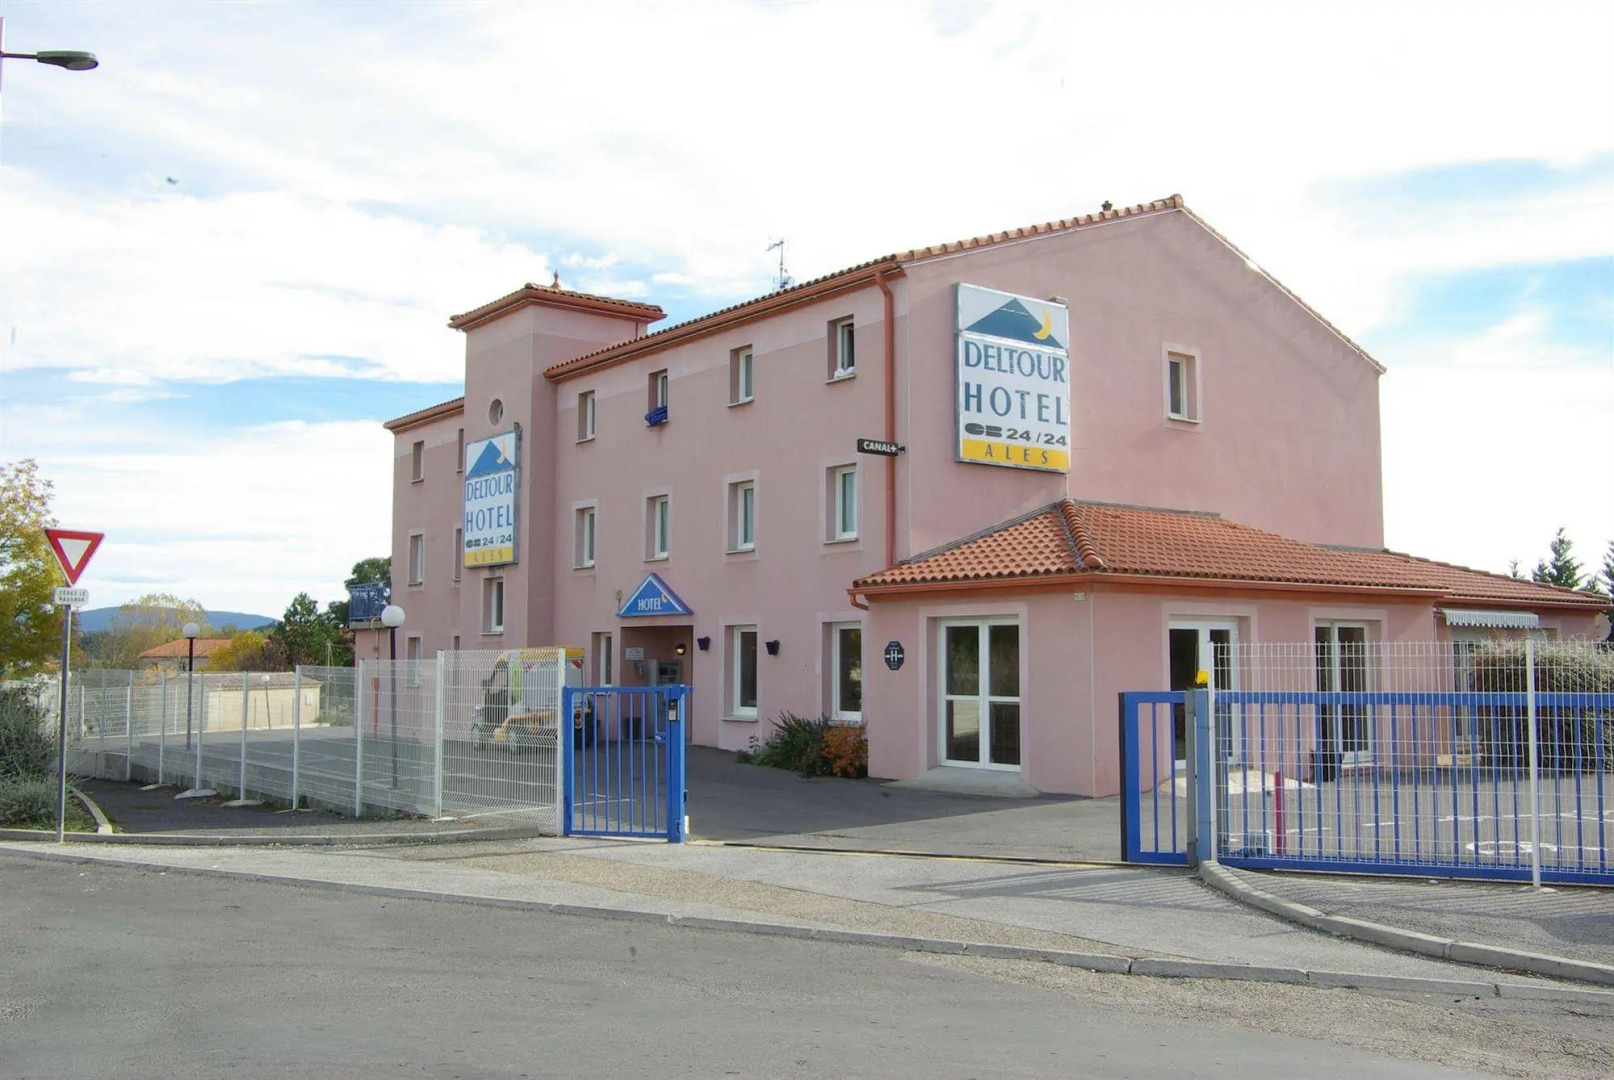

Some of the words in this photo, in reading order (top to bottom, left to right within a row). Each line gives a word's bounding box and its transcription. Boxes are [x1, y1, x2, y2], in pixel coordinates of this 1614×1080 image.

[964, 340, 1066, 383] DELTOUR
[964, 382, 1067, 426] HOTEL
[863, 441, 897, 453] CANAL+
[984, 443, 1049, 464] ALES
[466, 474, 513, 501] DELTOUR
[465, 504, 513, 533] HOTEL
[637, 597, 662, 611] HOTEL
[890, 650, 898, 662] H
